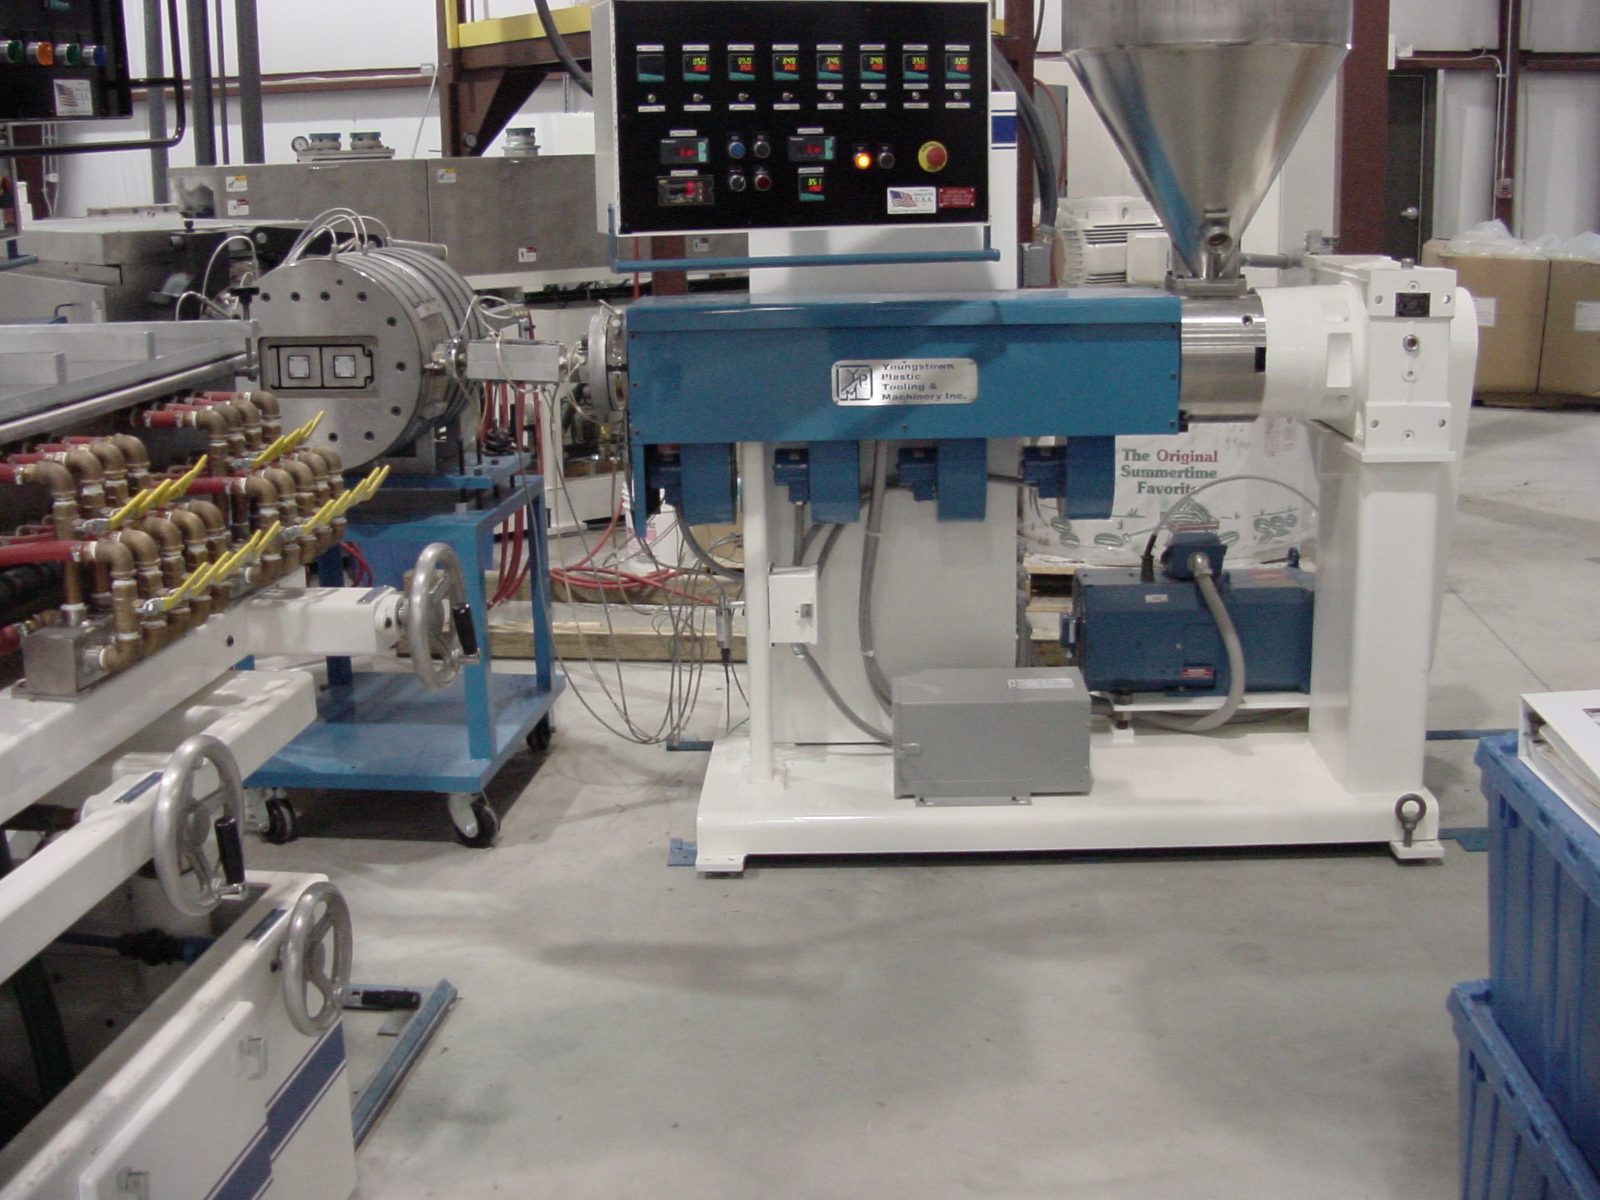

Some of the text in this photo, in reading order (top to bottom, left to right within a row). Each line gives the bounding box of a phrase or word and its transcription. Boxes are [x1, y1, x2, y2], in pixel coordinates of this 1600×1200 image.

[882, 363, 954, 371] Youngstown
[882, 382, 937, 391] Tooling &
[881, 392, 967, 401] Machinery Inc.
[1121, 448, 1218, 464] The Original
[1120, 464, 1218, 479] Summertime
